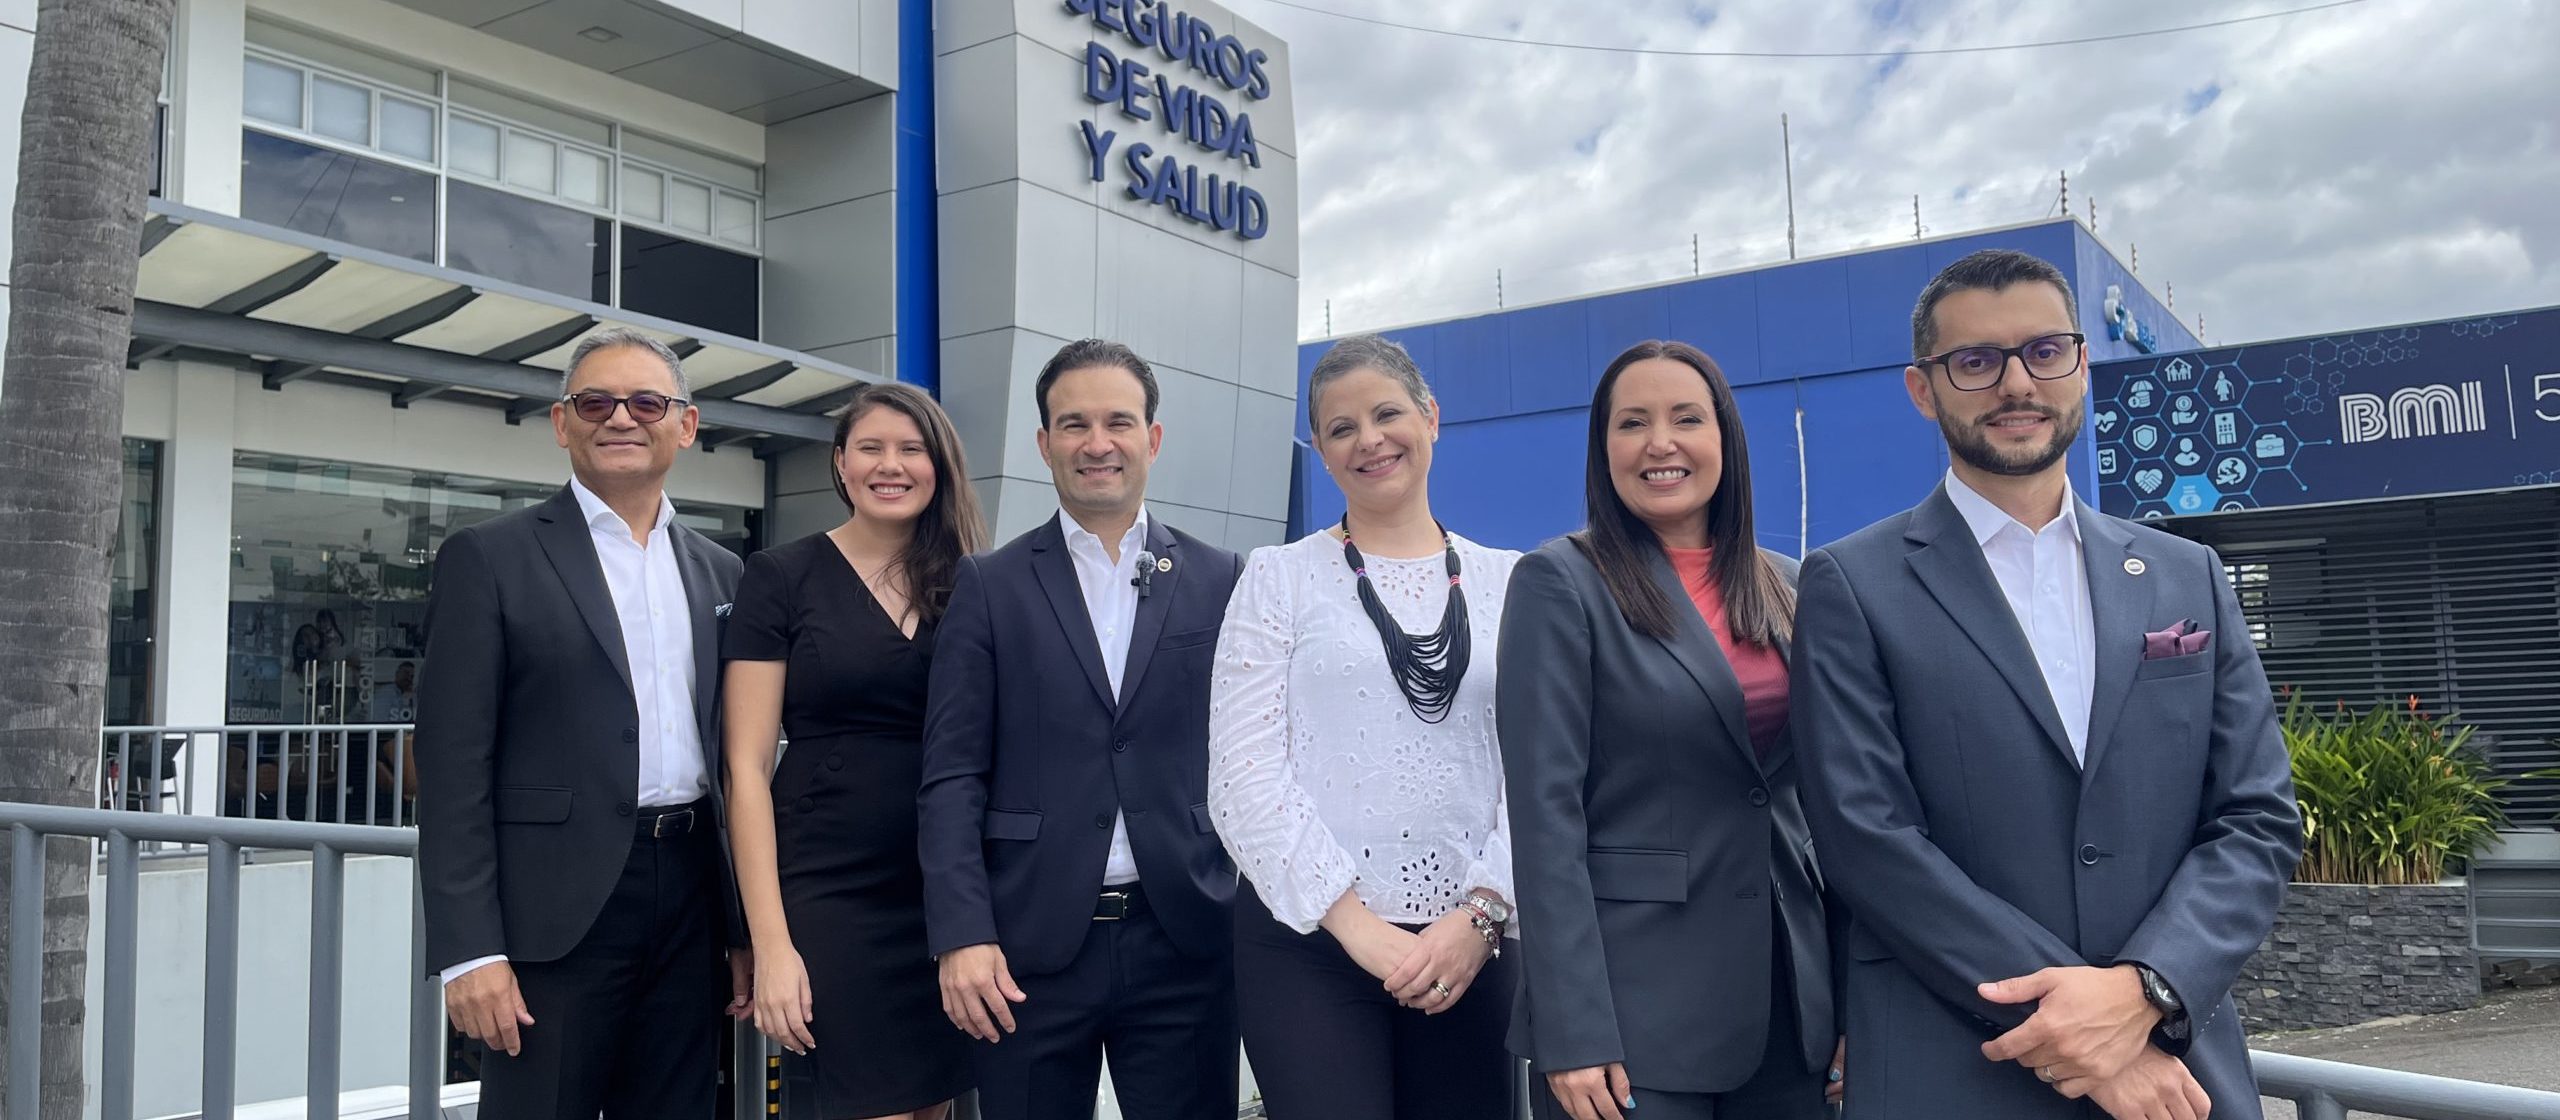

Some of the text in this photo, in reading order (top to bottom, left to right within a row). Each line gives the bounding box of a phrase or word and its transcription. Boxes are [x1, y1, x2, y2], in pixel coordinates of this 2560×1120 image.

[1065, 0, 1270, 100] EGUROS
[1086, 40, 1261, 169] DE VIDA
[1080, 119, 1269, 240] Y SALUD
[2339, 380, 2486, 444] BMI
